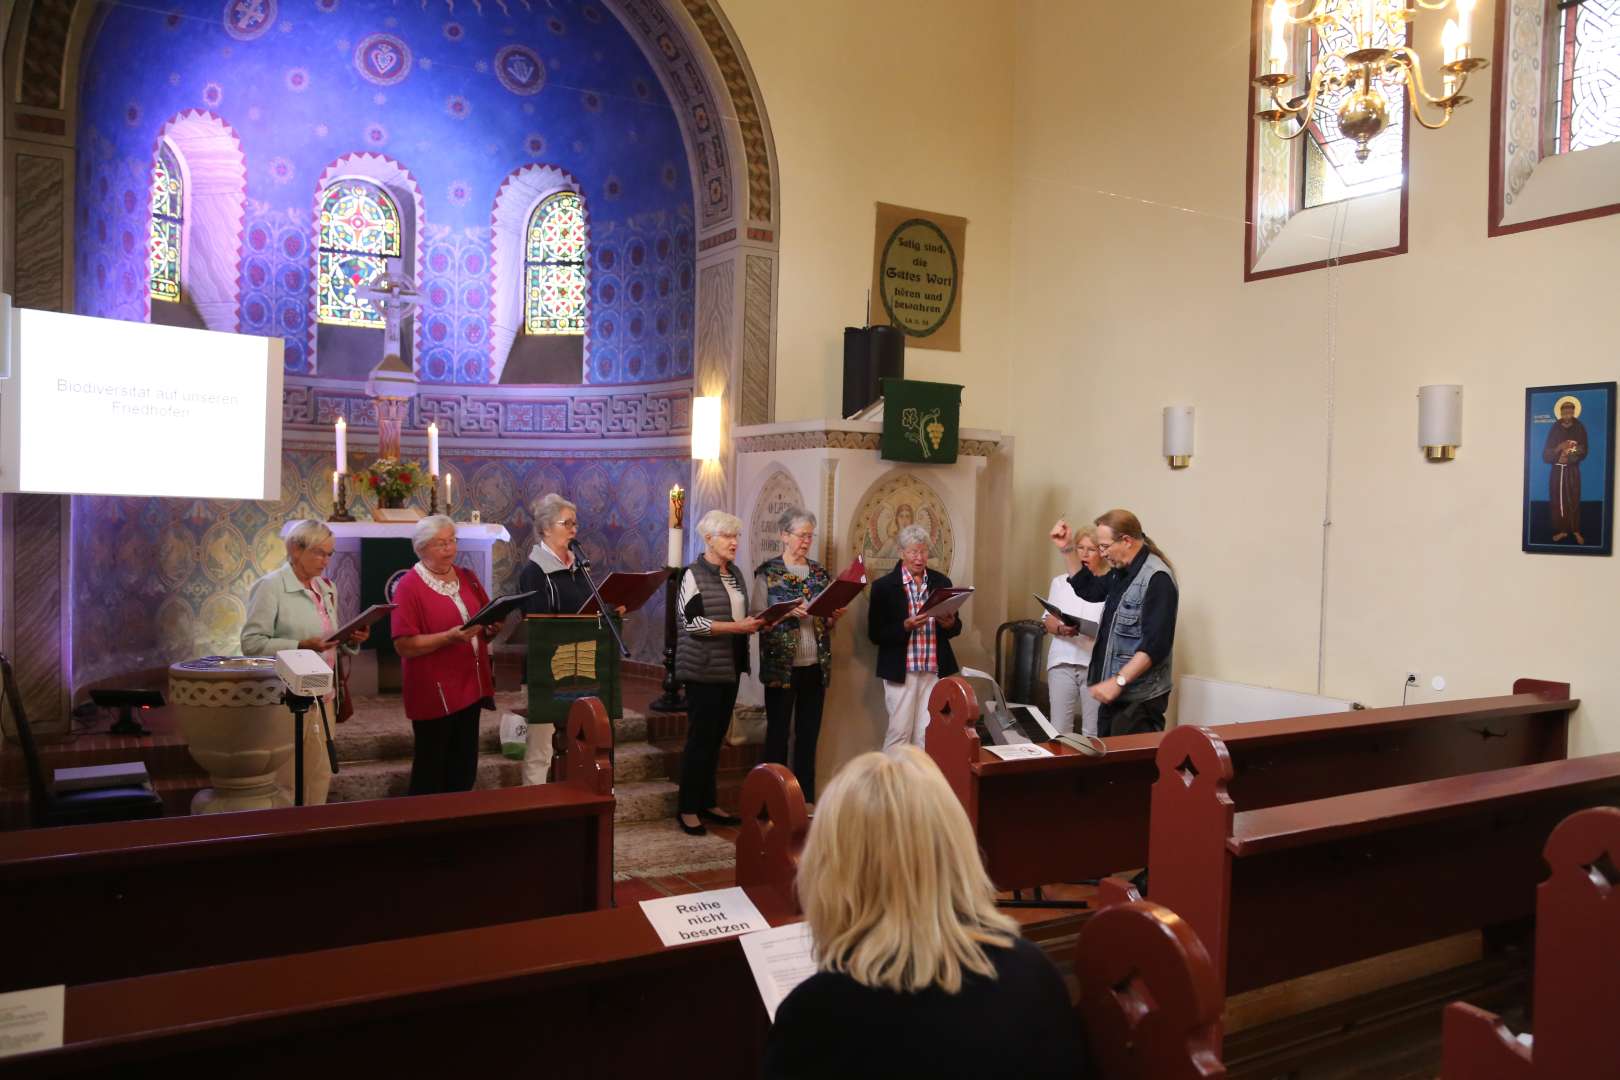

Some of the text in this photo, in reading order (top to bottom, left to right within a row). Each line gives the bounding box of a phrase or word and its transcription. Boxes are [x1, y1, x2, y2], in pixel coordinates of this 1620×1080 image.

[913, 257, 928, 268] die
[926, 272, 952, 287] Wort
[924, 292, 943, 302] und
[155, 386, 178, 400] auf
[182, 392, 239, 406] unseren
[676, 900, 721, 914] Reihe
[687, 911, 728, 926] nicht
[678, 921, 751, 940] besetzen
